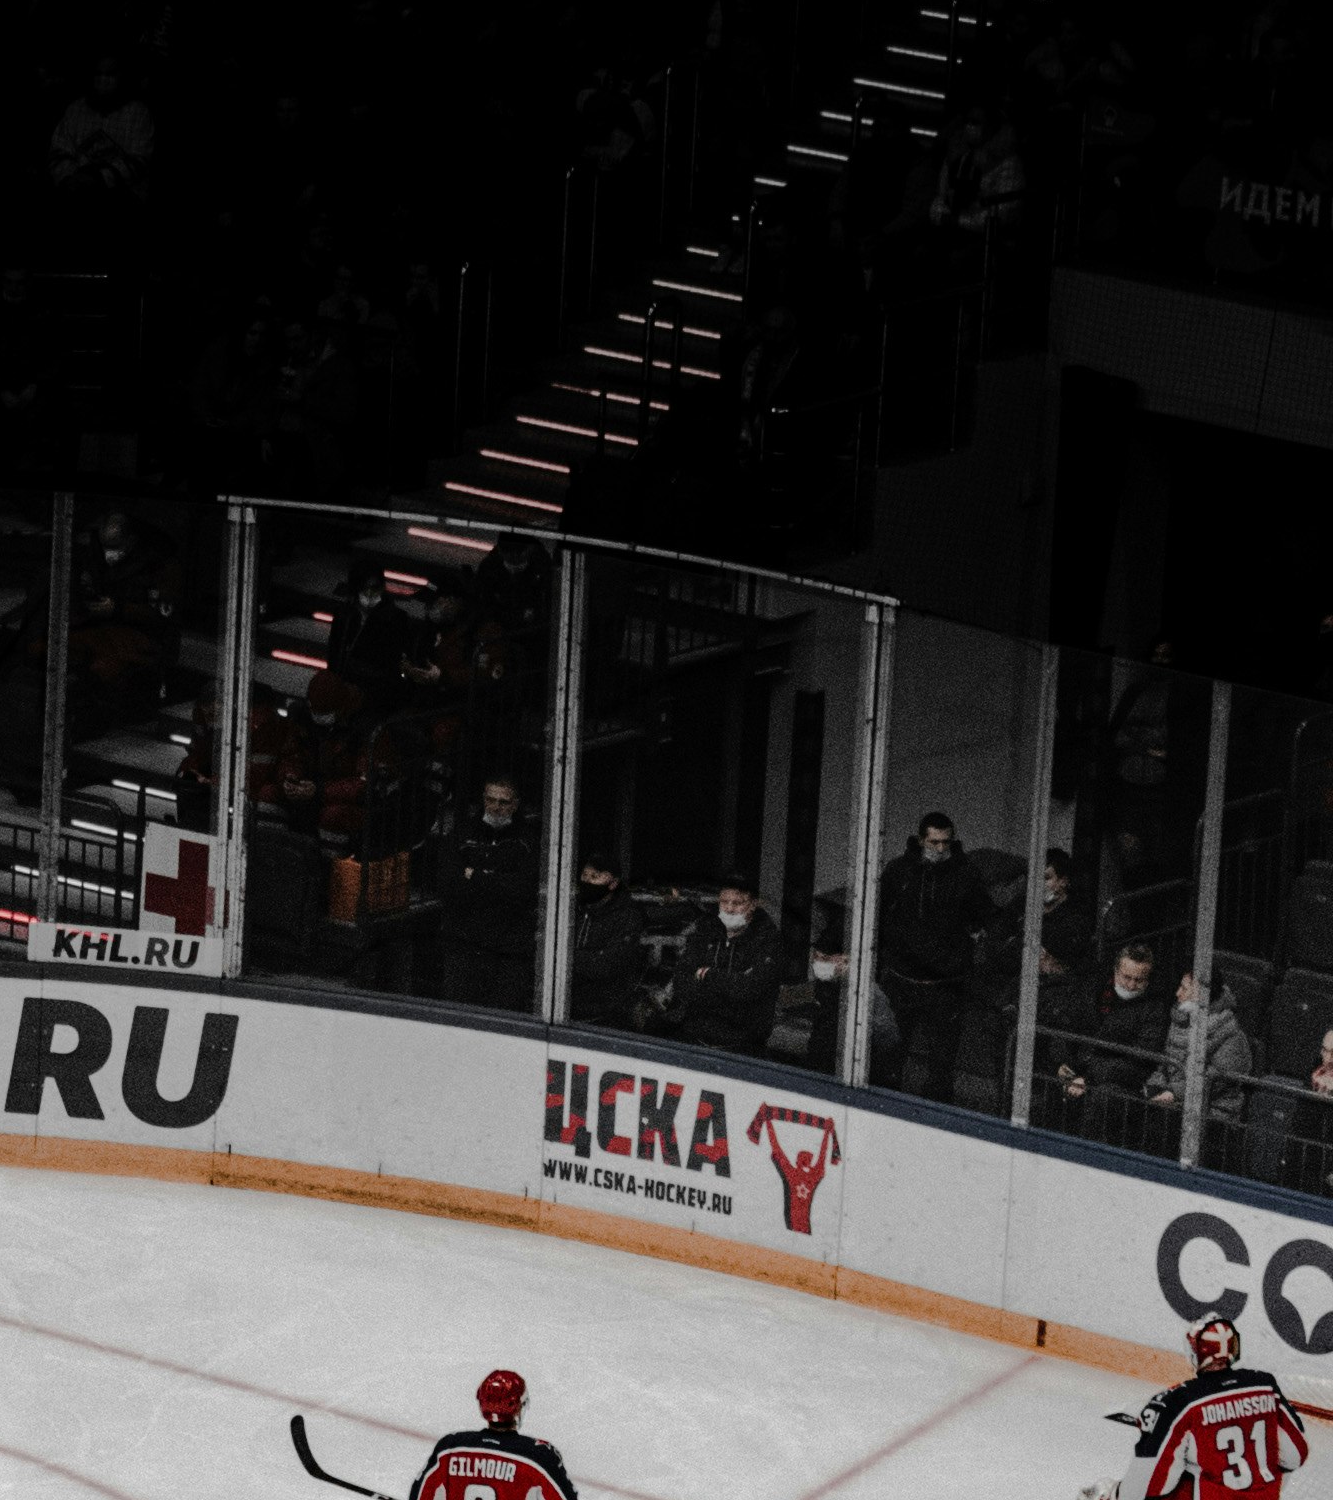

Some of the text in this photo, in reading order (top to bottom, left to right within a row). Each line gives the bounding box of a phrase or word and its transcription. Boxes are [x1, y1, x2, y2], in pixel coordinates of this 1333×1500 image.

[1219, 175, 1321, 228] ИДЕМ
[52, 929, 200, 969] KHL.RU
[543, 1057, 732, 1179] ЦСКА
[542, 1157, 733, 1216] WWW.CSKA-HOCKEY.RU
[1201, 1394, 1277, 1427] JOHANSSON
[448, 1456, 517, 1483] GILMOUR
[1215, 1419, 1276, 1491] 31
